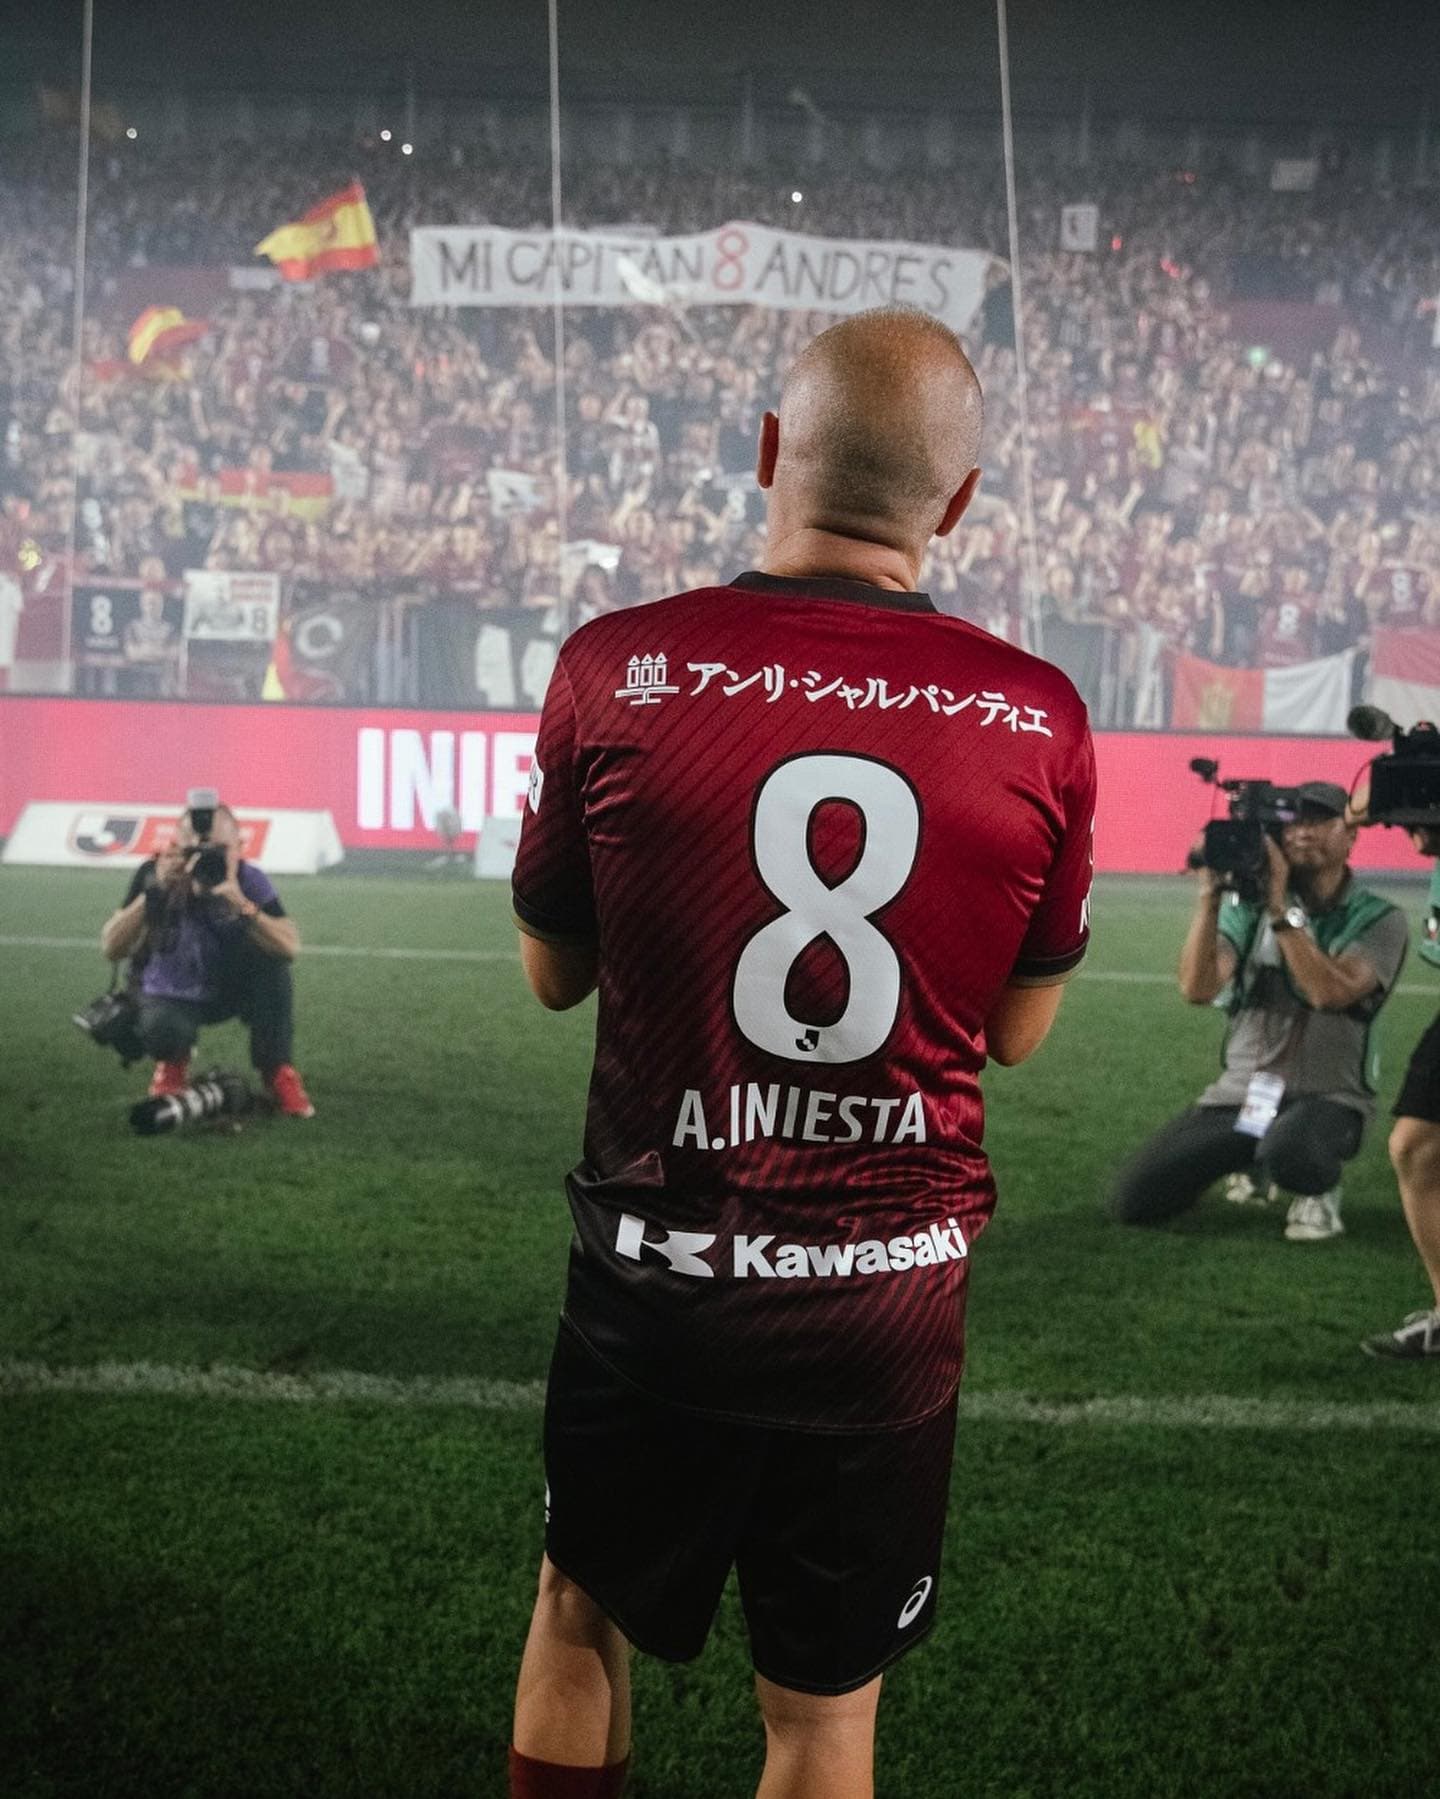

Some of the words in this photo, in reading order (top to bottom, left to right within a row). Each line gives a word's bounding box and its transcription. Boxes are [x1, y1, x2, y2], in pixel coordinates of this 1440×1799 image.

[438, 240, 492, 292] MI
[505, 238, 704, 295] CAPITAN
[711, 229, 749, 291] 8
[753, 238, 952, 313] ANDRES
[91, 595, 113, 635] 8
[687, 661, 1054, 738] アンリ・シャルパンティエ
[731, 753, 921, 1065] 8
[672, 1082, 927, 1151] A.INIESTA
[733, 1217, 968, 1279] Kawasaki
